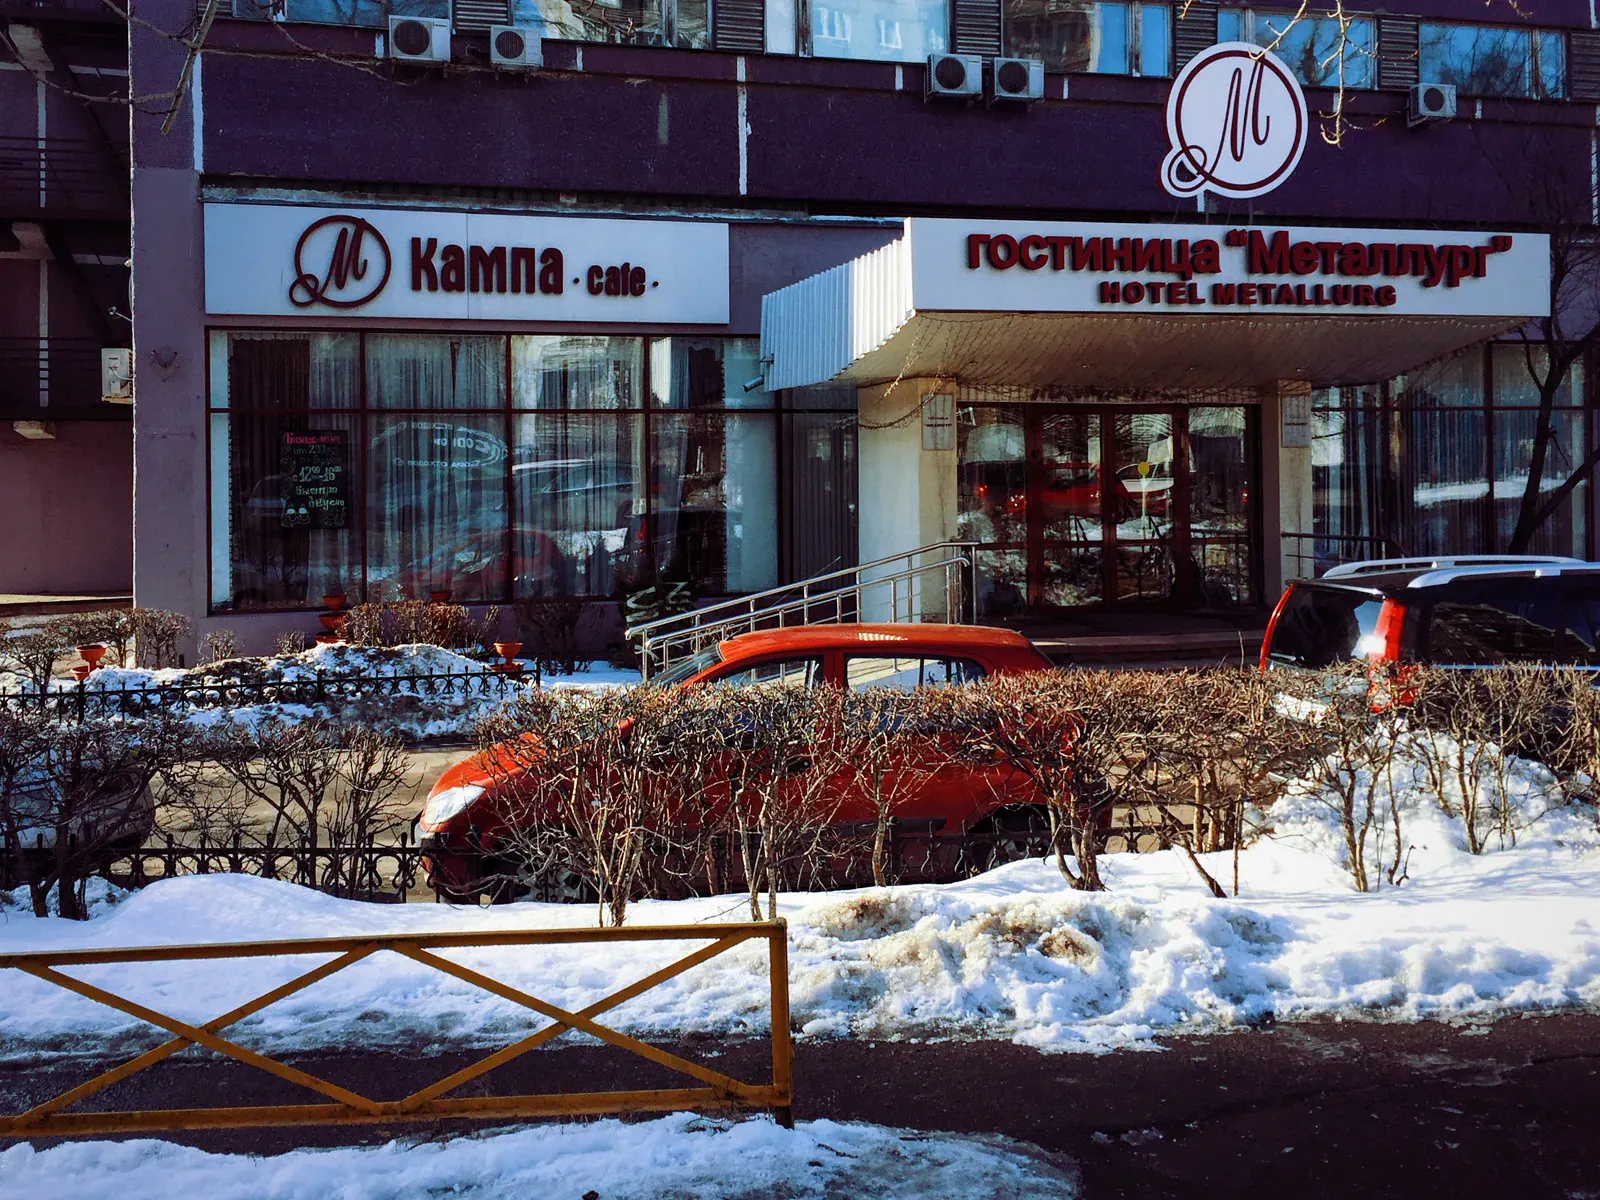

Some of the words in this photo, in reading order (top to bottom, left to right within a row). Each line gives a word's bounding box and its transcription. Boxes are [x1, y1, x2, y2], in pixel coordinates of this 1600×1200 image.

[411, 237, 563, 297] Кампа
[1098, 281, 1206, 305] HOTEL
[1211, 282, 1397, 307] METALLURG
